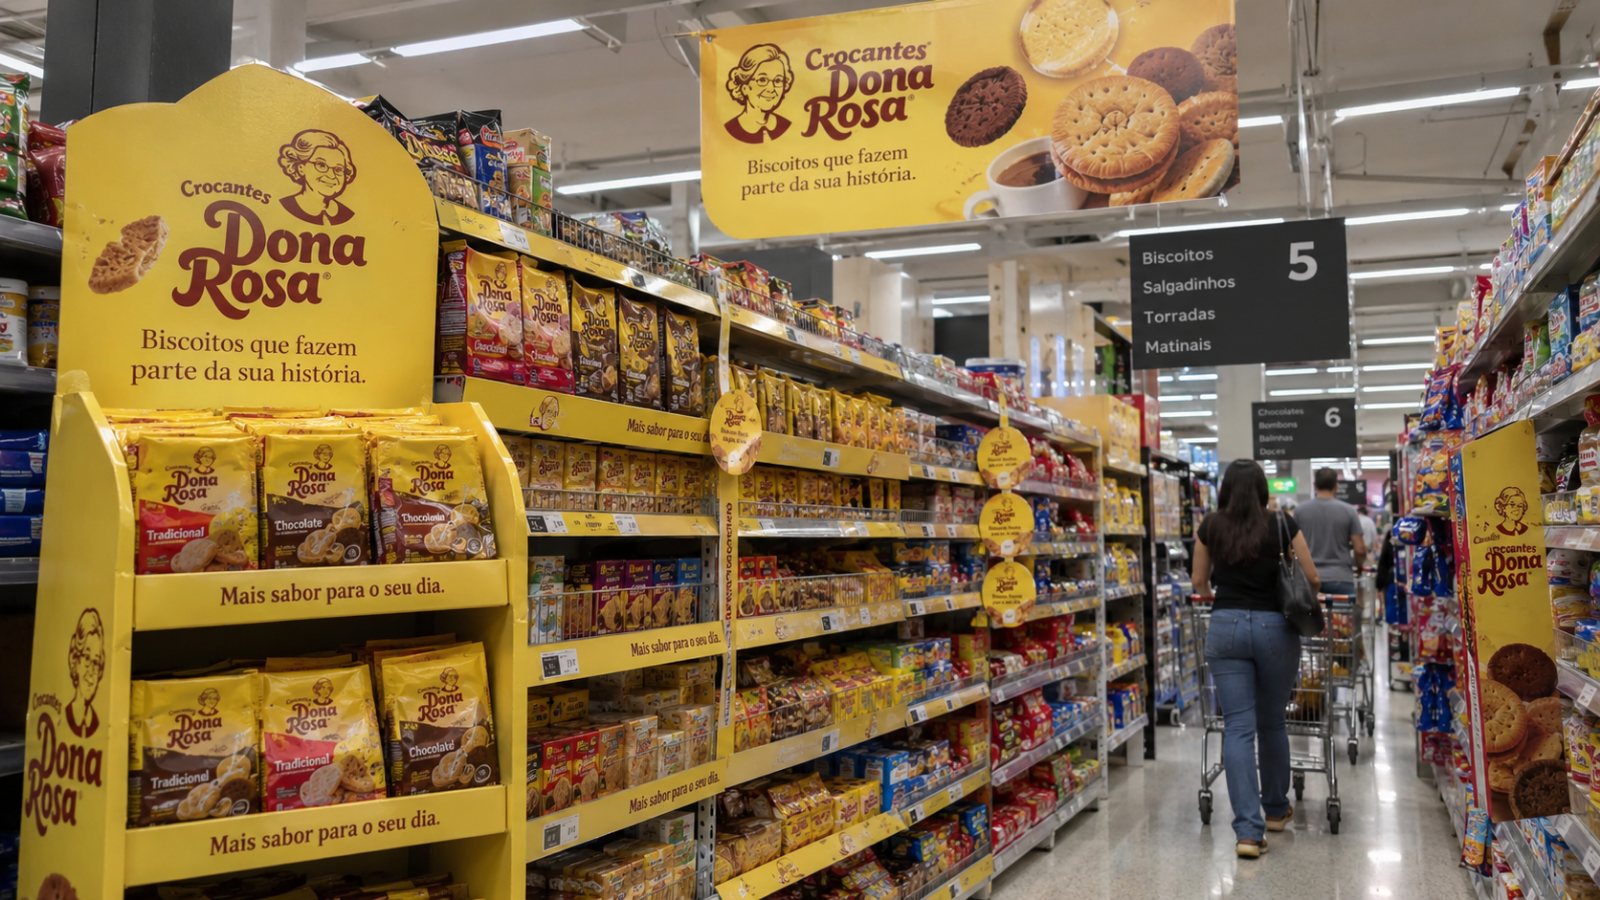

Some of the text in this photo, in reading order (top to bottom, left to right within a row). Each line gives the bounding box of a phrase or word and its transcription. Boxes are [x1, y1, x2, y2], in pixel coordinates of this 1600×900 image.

[805, 42, 929, 70] Crocantes
[829, 64, 934, 103] Dona
[747, 145, 908, 175] Biscoitos que fazem
[180, 179, 272, 204] Crocantes
[741, 165, 916, 201] parte da sua história.
[203, 200, 367, 266] Dona
[1142, 241, 1318, 281] Biscoitos 5
[480, 280, 512, 301] Dona
[1143, 277, 1236, 296] Salgadinhos
[534, 293, 562, 314] Dona
[1144, 308, 1216, 324] Torradas
[141, 328, 357, 358] Biscoitos que fazem
[1145, 338, 1212, 354] Matinais
[131, 361, 367, 386] parte da sua história.
[1258, 406, 1341, 428] Chocolates 6
[627, 417, 646, 434] Mais
[647, 421, 666, 439] sabor
[667, 427, 683, 442] para
[684, 429, 689, 439] o
[690, 430, 701, 442] seu
[171, 470, 218, 488] Dona
[293, 465, 336, 484] Dona
[415, 465, 454, 482] Dona
[161, 484, 207, 505] Rosa
[286, 480, 327, 499] Rosa
[410, 478, 445, 496] Rosa
[146, 526, 205, 541] Tradicional
[1484, 551, 1543, 575] Dona
[220, 576, 445, 606] Mais sabor para o seu dia.
[1477, 568, 1529, 597] Rosa
[630, 641, 650, 657] Mais
[651, 637, 672, 653] sabor
[672, 637, 689, 653] para
[689, 638, 695, 647] o
[697, 635, 707, 646] seu
[422, 691, 464, 708] Dona
[292, 703, 338, 720] Dona
[417, 704, 456, 723] Rosa
[174, 714, 223, 733] Dona
[285, 716, 328, 735] Rosa
[37, 712, 103, 787] Dona
[166, 729, 212, 750] Rosa
[273, 753, 330, 771] Tradicional
[25, 758, 77, 837] Rosa
[628, 798, 648, 814] Mais
[649, 791, 671, 807] sabor
[671, 786, 688, 802] para
[688, 783, 694, 792] o
[695, 779, 707, 790] seu
[210, 810, 441, 857] Mais sabor para o seu dia.
